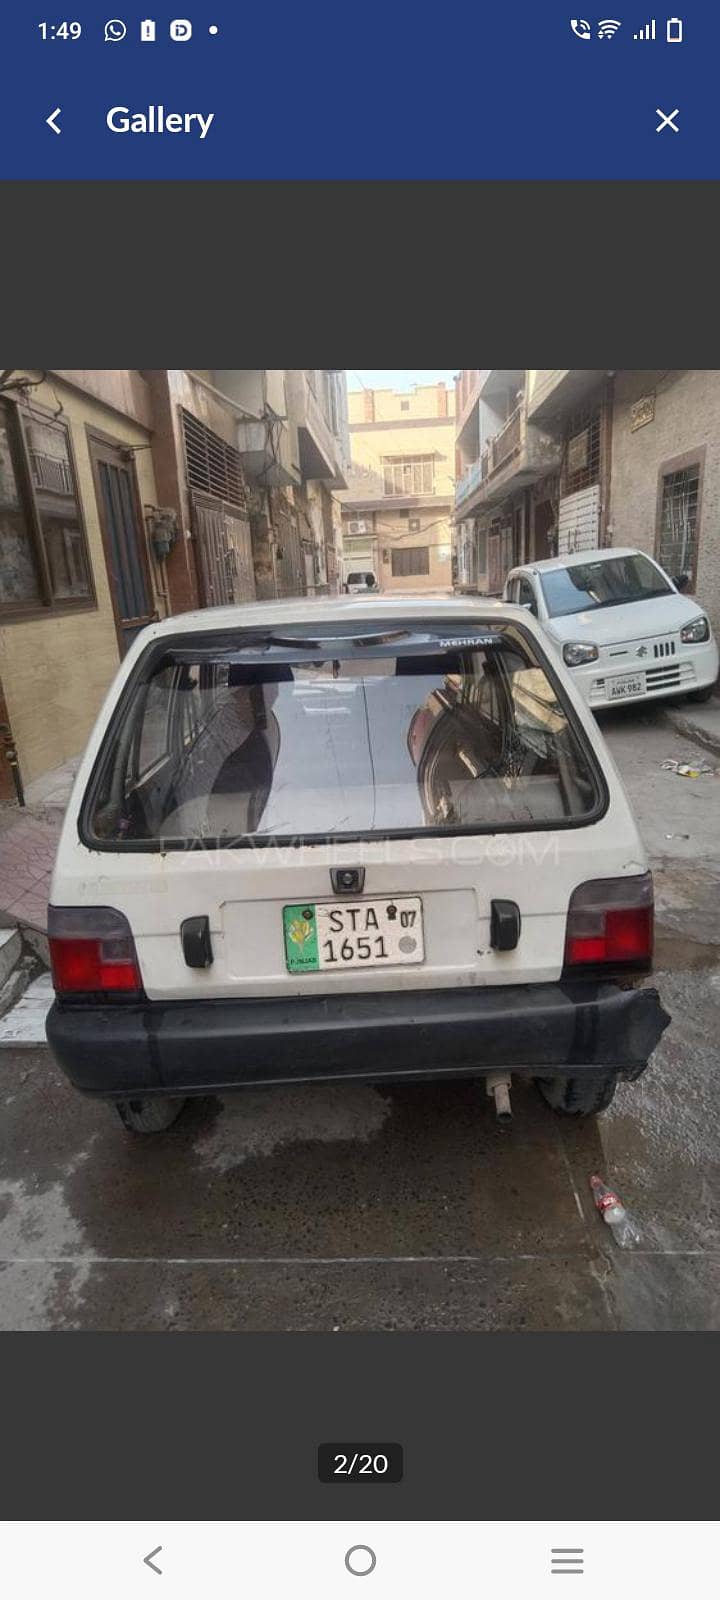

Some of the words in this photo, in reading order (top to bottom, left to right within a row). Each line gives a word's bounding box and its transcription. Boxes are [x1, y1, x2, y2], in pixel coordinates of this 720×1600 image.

[329, 908, 379, 932] STA
[400, 910, 416, 928] 07
[323, 936, 389, 962] 1651
